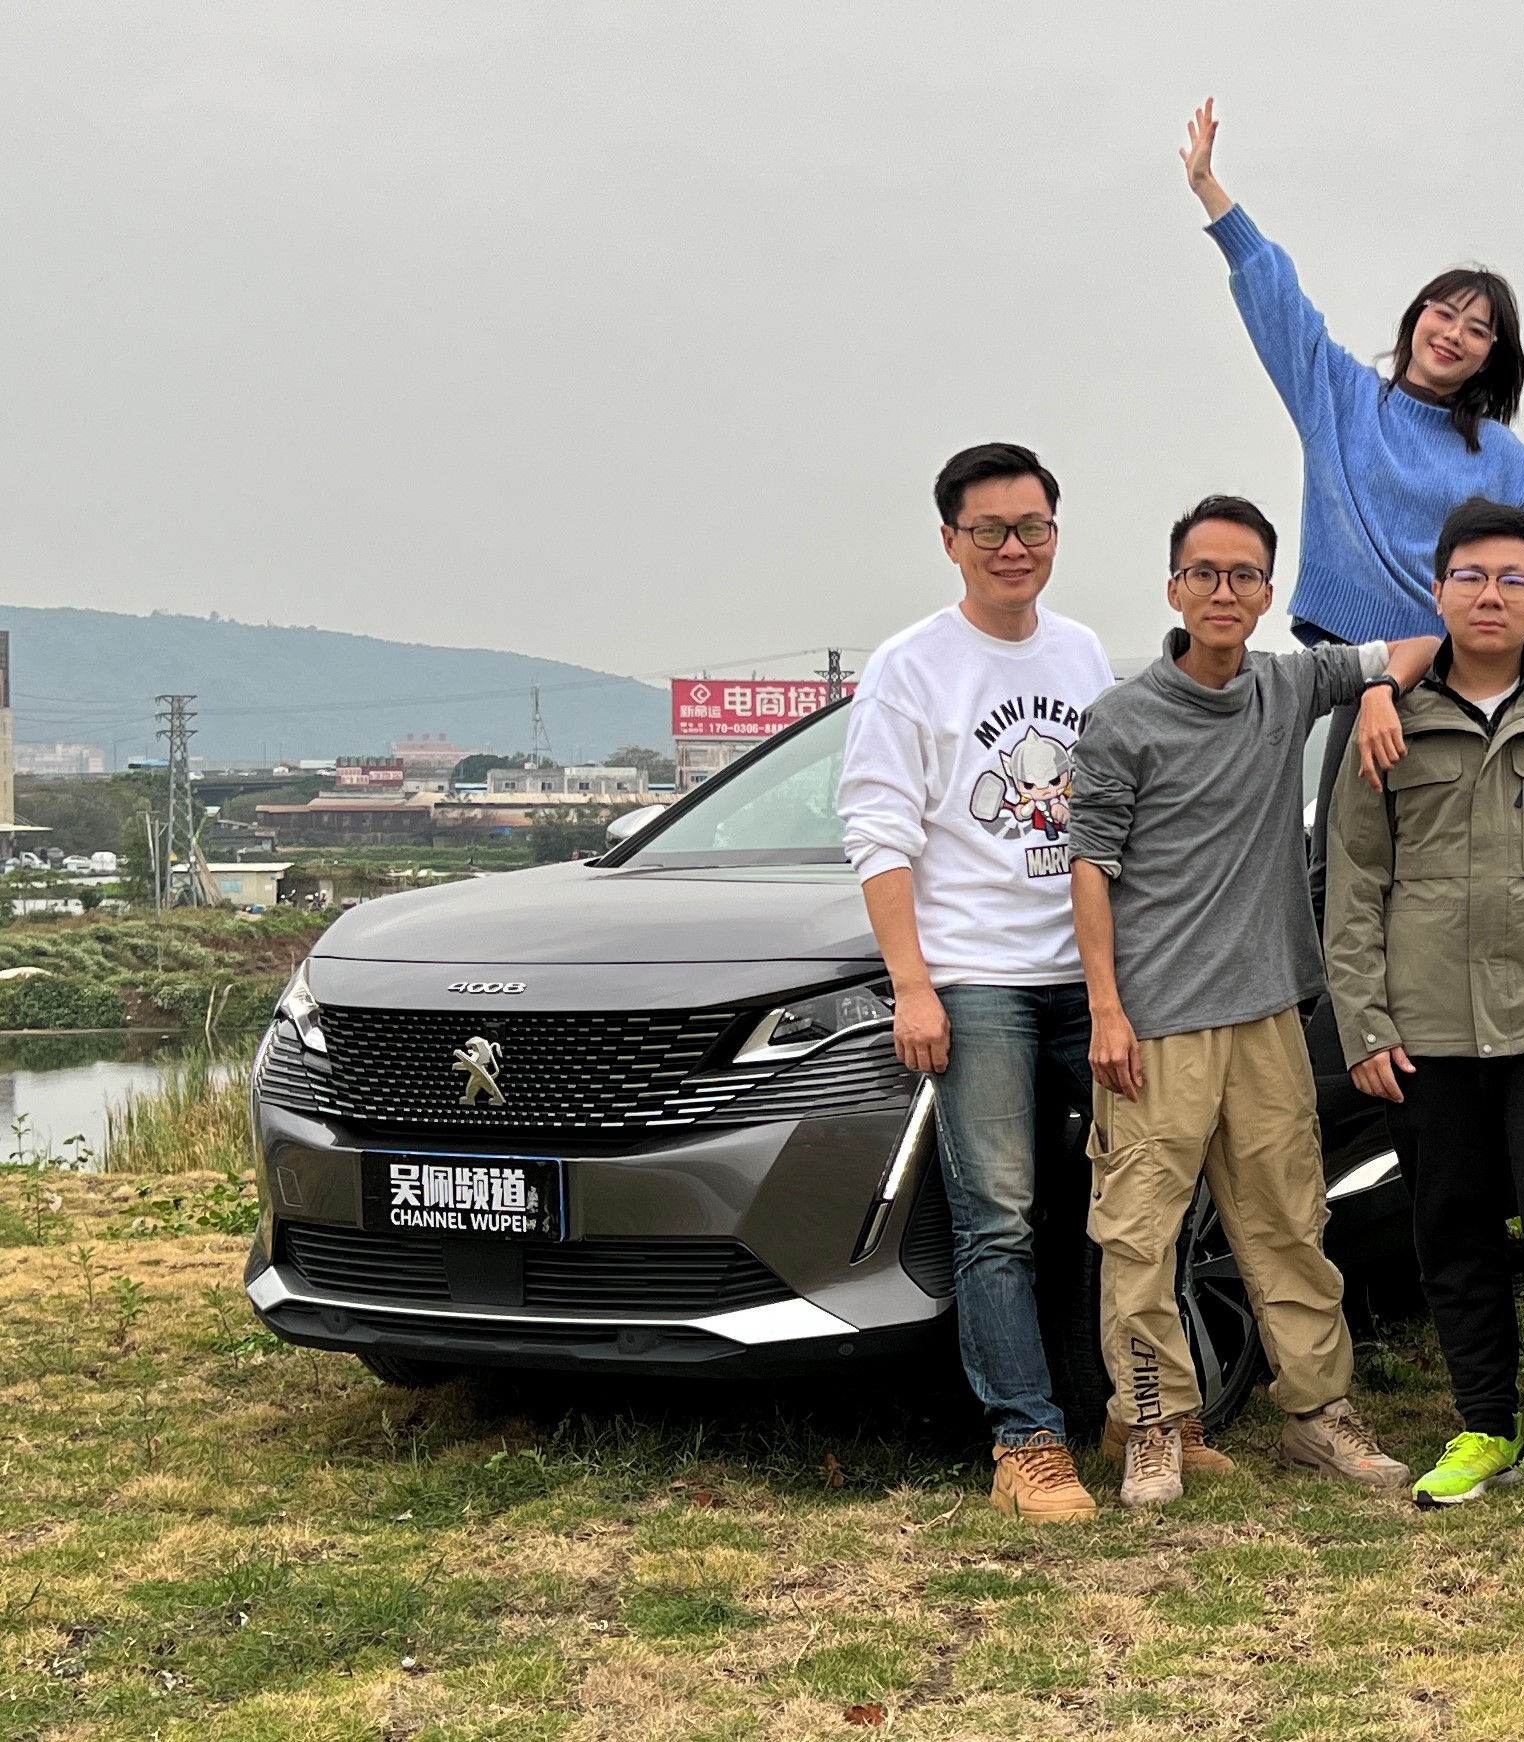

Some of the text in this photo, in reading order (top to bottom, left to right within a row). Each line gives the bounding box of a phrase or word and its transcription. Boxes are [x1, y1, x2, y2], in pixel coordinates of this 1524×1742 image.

[974, 696, 1025, 750] MINI
[448, 981, 527, 994] 4008
[390, 1163, 526, 1213] 吴佩频道
[390, 1208, 527, 1233] CHANNEL WUPEI
